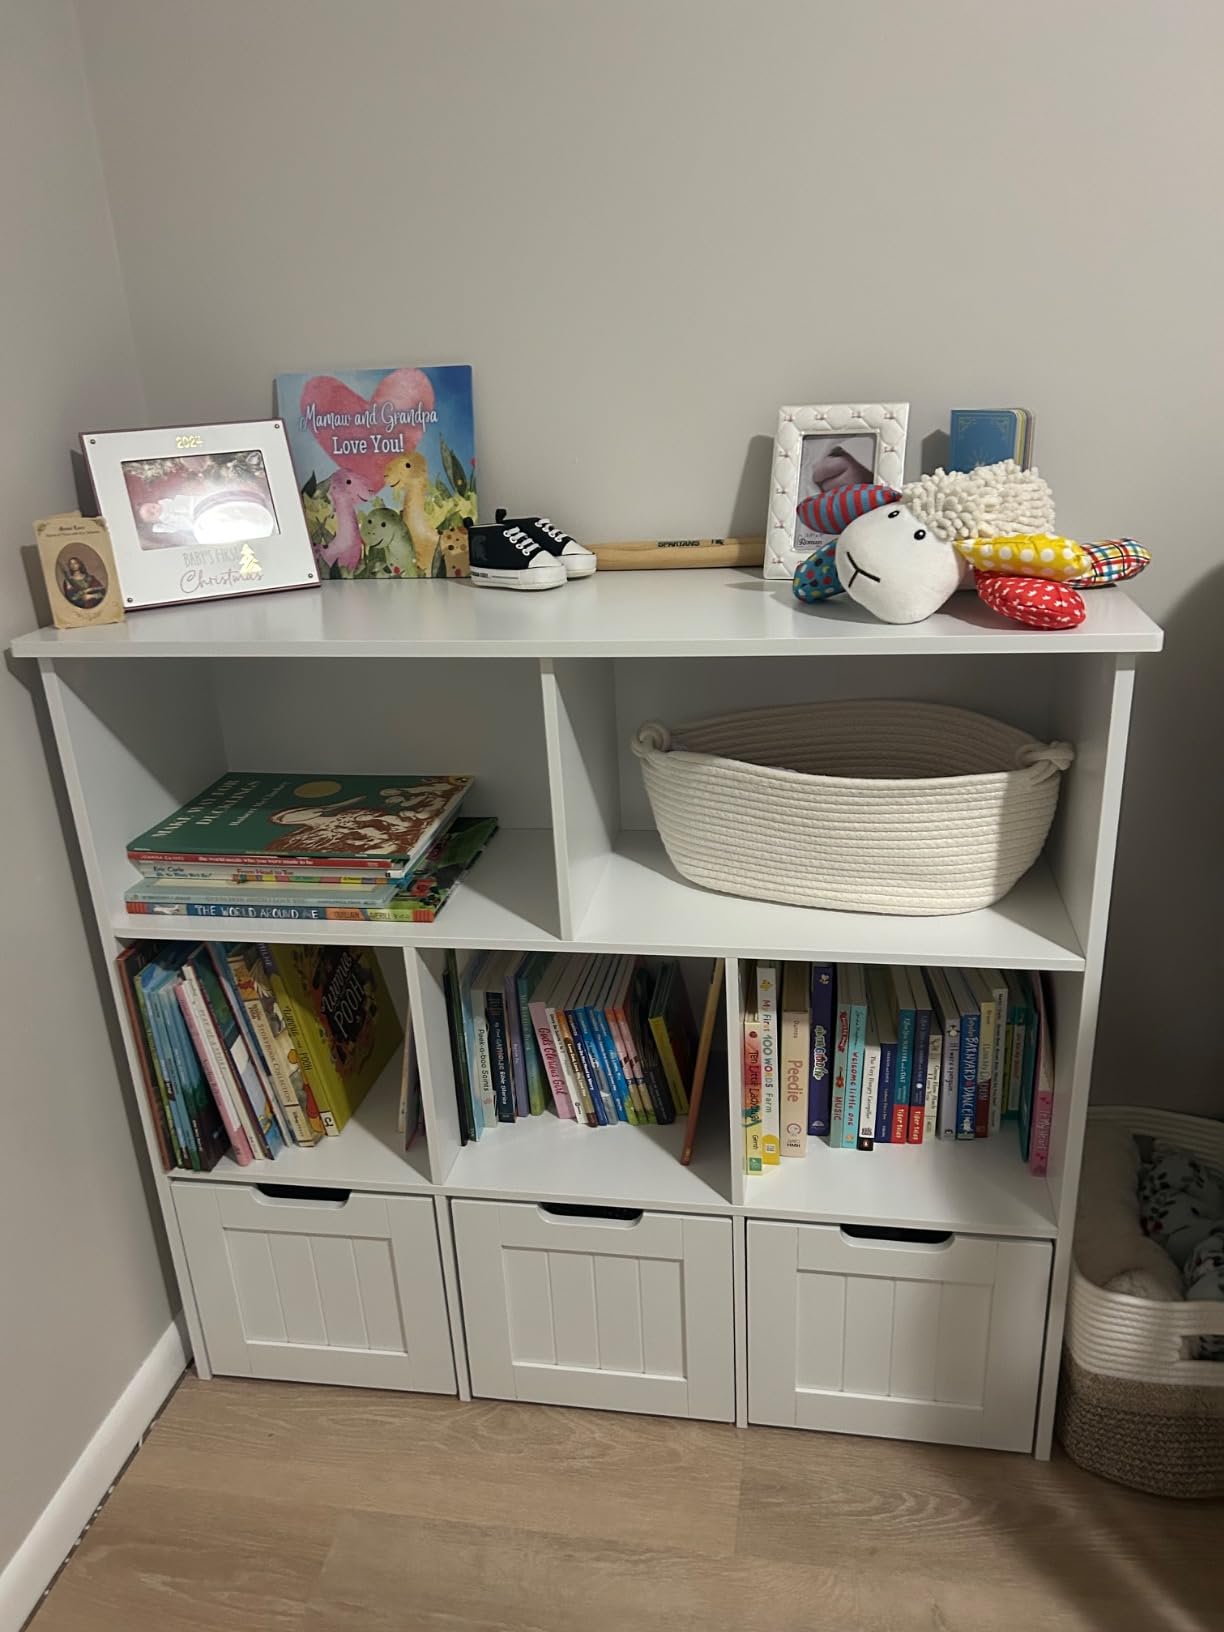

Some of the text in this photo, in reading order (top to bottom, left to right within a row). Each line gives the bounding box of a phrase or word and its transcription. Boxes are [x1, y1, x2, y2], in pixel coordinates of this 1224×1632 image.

[303, 401, 438, 432] Mamaw and Grandpa
[332, 434, 404, 454] Love You!
[215, 545, 242, 565] FIRS
[180, 568, 264, 593] Christmas
[194, 905, 218, 915] THE
[221, 905, 257, 918] WORLD
[260, 907, 299, 919] AROUND
[334, 974, 365, 1039] POOH
[477, 1028, 490, 1091] Peek-a-boo Saints
[750, 1050, 759, 1063] Ten
[762, 1000, 775, 1113] My First 100 WORDS Farm
[543, 1046, 560, 1076] Glorious
[553, 1077, 567, 1096] Girl
[749, 1065, 760, 1085] Little
[787, 1060, 803, 1102] Peedie
[961, 1037, 978, 1117] BARNYARD DANCE!
[834, 1096, 843, 1120] MUSIC
